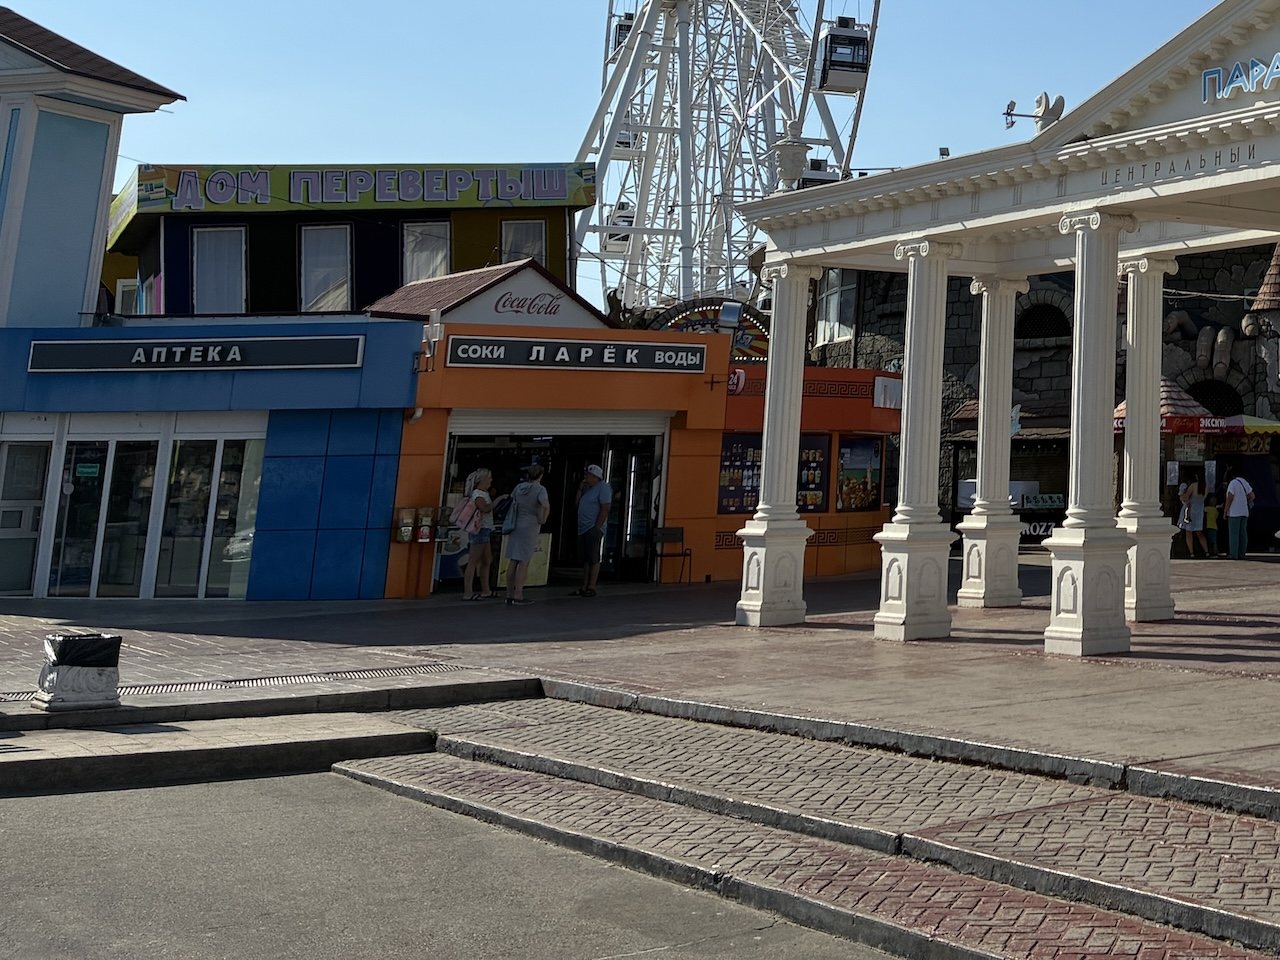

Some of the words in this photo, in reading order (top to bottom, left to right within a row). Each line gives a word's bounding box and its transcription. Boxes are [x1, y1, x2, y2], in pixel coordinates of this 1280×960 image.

[173, 170, 271, 210] ДОМ
[289, 169, 569, 203] ПЕРЕВЕРТЫШ
[494, 291, 566, 315] Coca-Cola
[131, 345, 243, 364] АПТЕКА
[457, 344, 506, 359] СОКИ
[529, 345, 640, 364] ЛАРЁК
[654, 350, 701, 366] ВОДЫ
